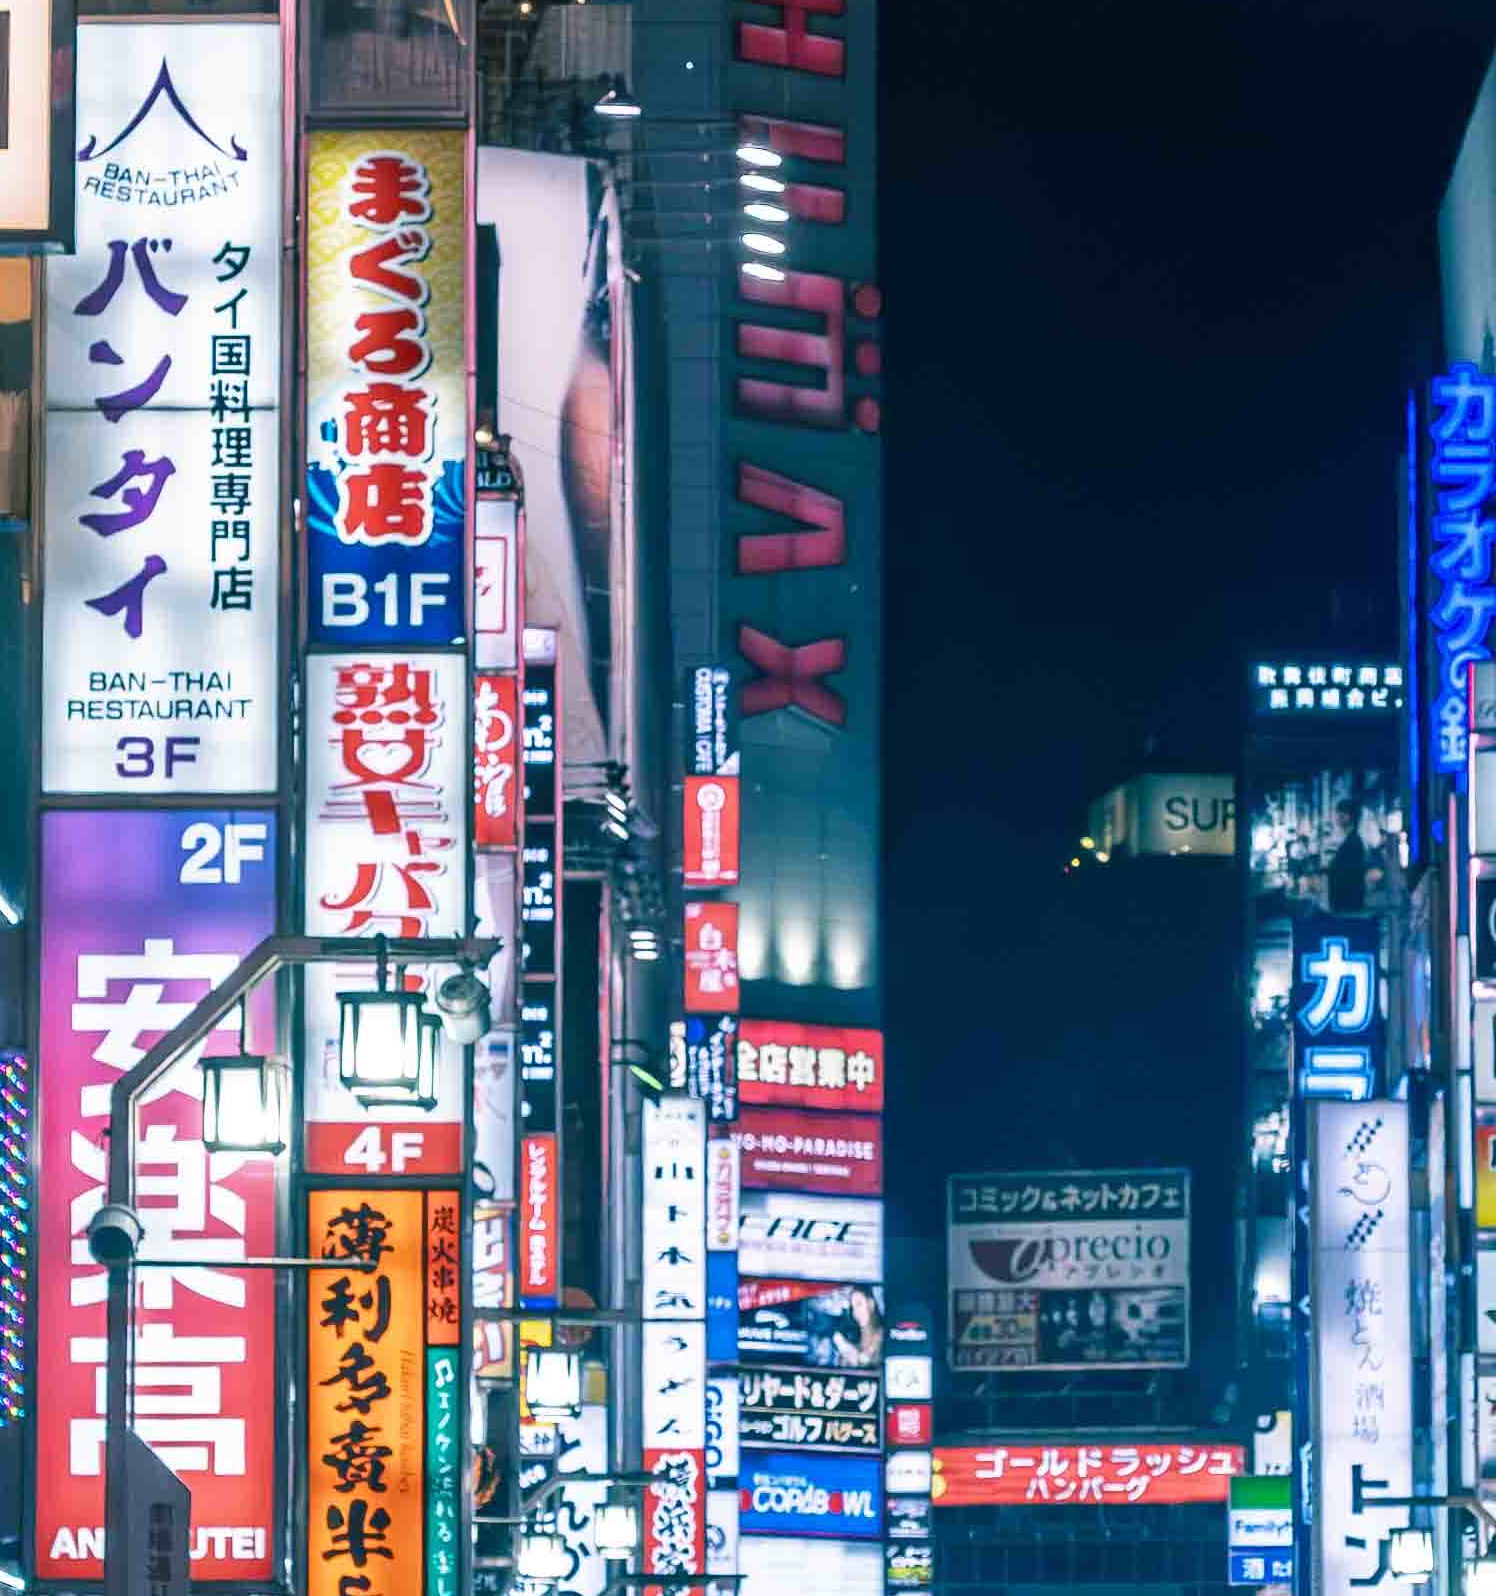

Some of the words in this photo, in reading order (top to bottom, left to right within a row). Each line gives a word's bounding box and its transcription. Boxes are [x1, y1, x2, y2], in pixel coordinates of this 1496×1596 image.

[342, 153, 440, 543] まぐろ商店
[73, 236, 189, 639] バンタイ
[210, 241, 254, 612] タイ国料理専門店
[320, 571, 450, 628] B1F
[88, 670, 234, 694] BAN-THAI
[66, 698, 253, 722] RESTAURANT
[115, 736, 201, 779] 3F
[178, 822, 268, 884] 2F
[737, 1041, 876, 1094] 全店営業中
[345, 1127, 423, 1174] 4F
[428, 1205, 459, 1327] 炭火串焼
[739, 1374, 878, 1413] リヤード&ダーツ
[974, 1447, 1238, 1479] ゴールドラッシュ
[1025, 1473, 1152, 1503] ハンバーグ
[50, 1527, 266, 1562] ANUTEI
